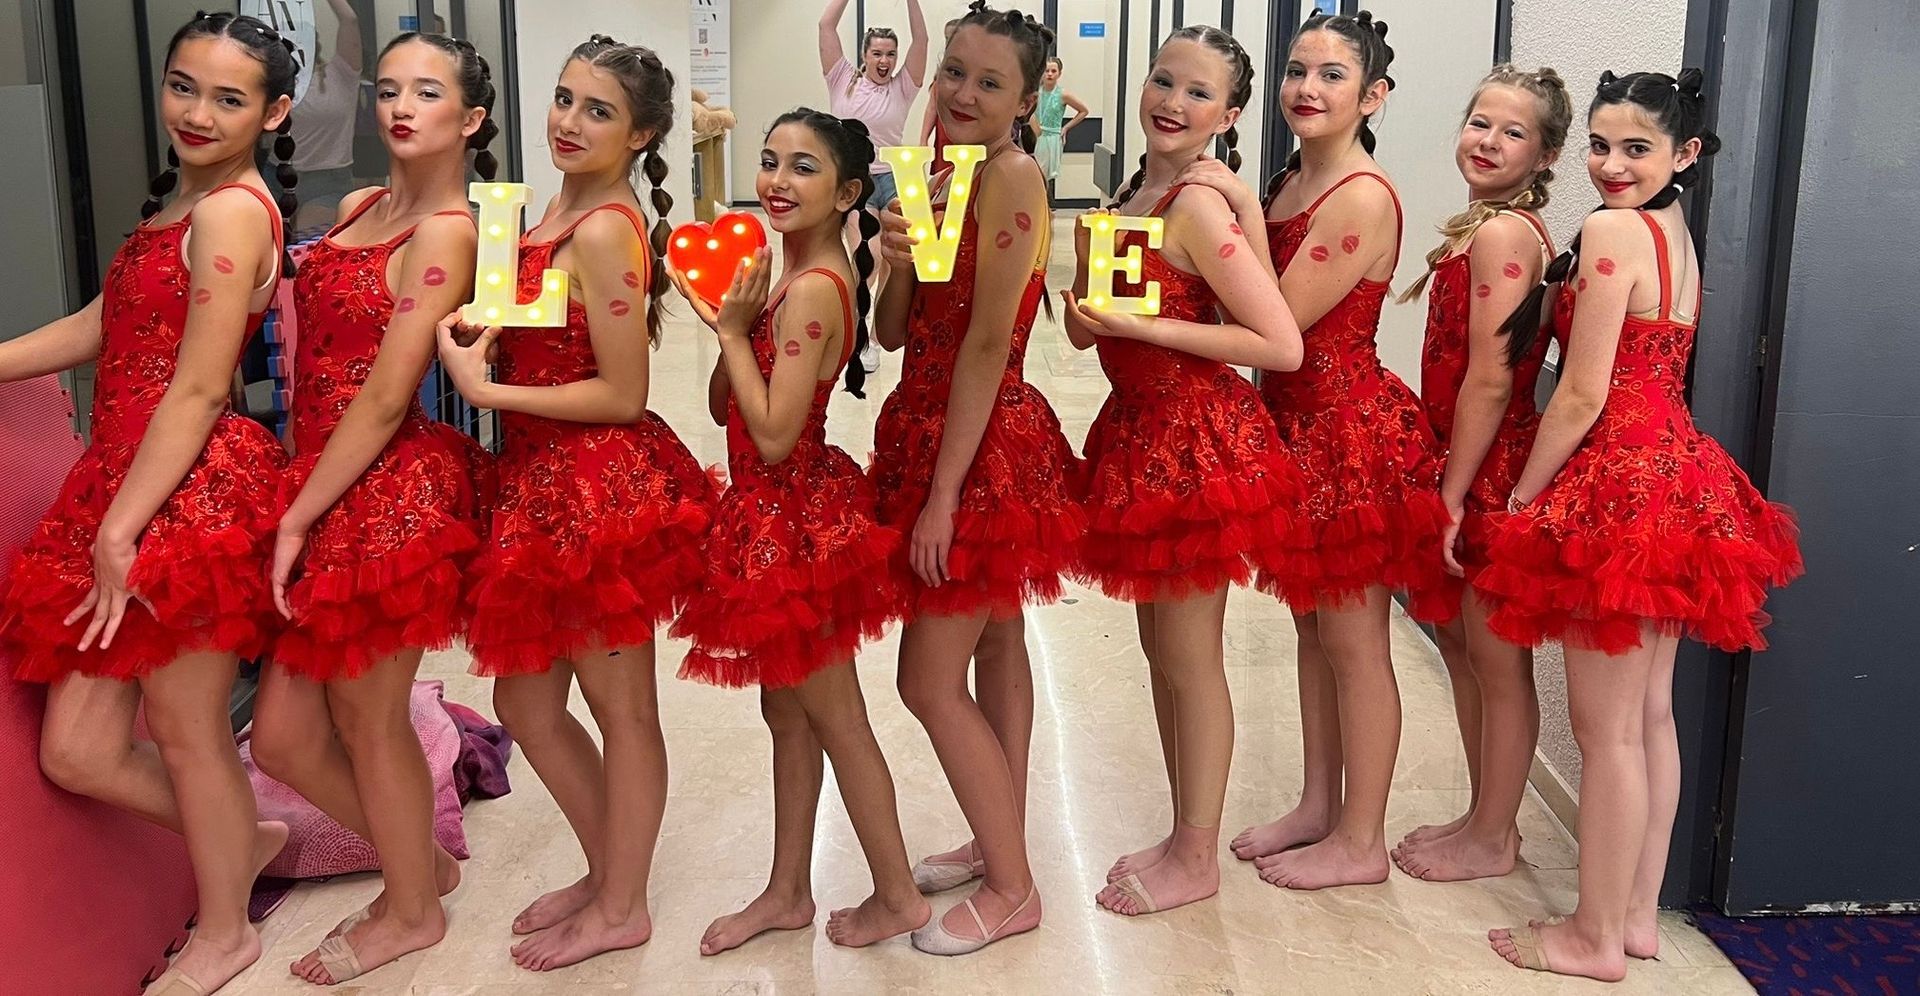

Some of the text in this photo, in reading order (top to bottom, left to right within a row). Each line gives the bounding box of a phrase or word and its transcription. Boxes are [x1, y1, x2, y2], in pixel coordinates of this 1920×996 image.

[462, 144, 1164, 328] L V E
